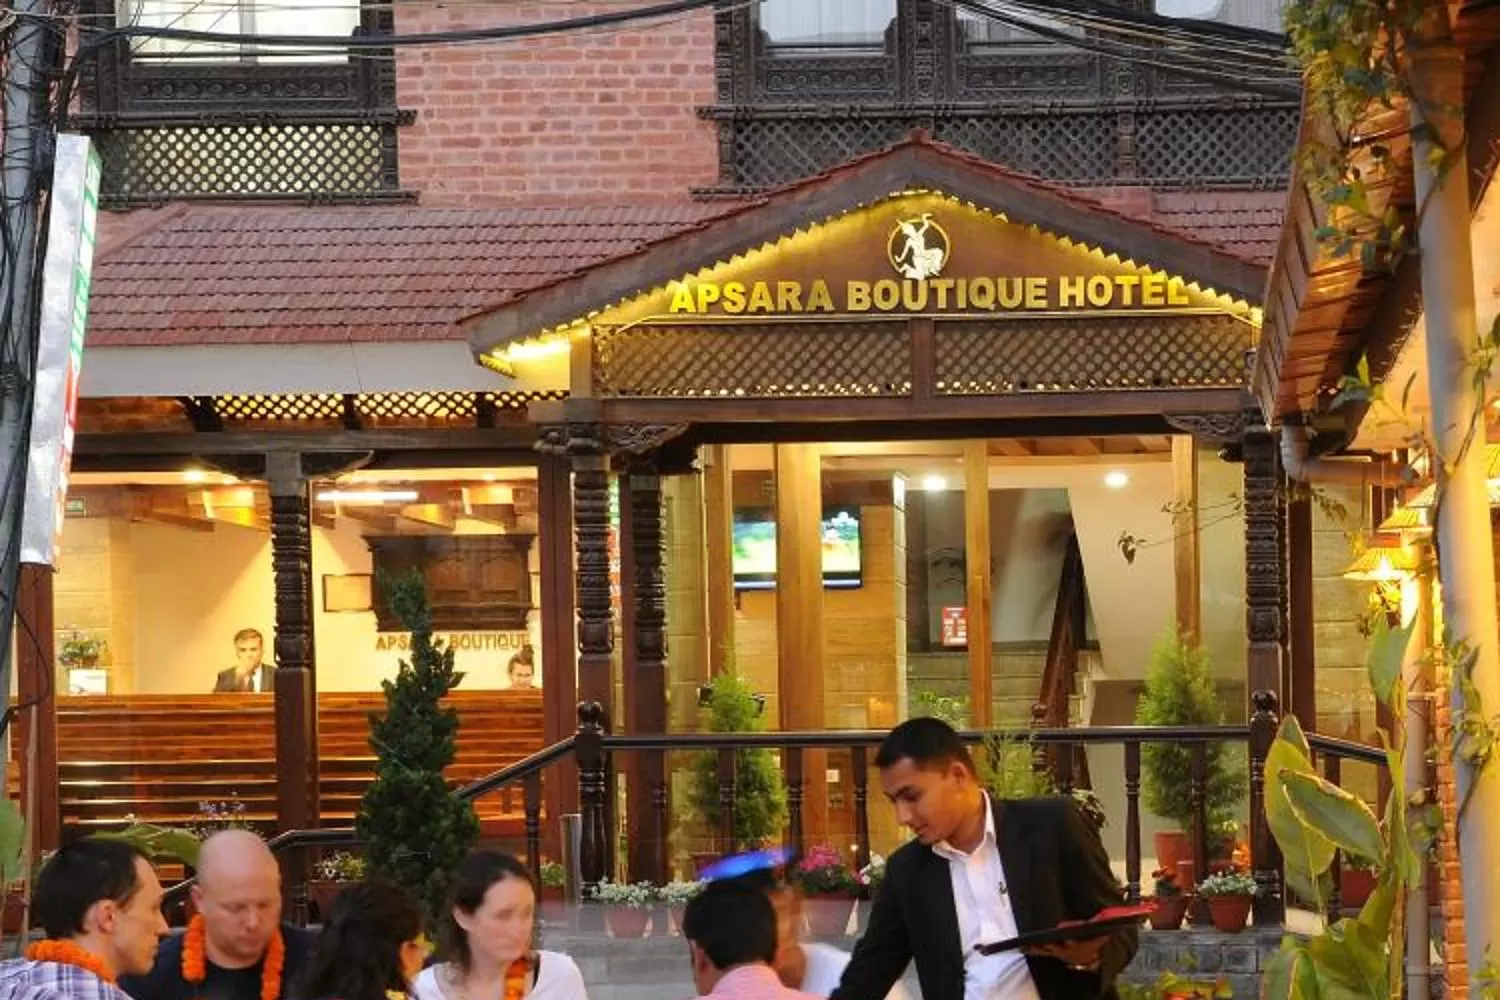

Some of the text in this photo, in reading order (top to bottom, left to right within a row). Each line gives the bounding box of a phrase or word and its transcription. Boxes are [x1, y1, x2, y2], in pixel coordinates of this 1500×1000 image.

[669, 273, 1190, 314] APSARA BOUTIQUE HOTEL
